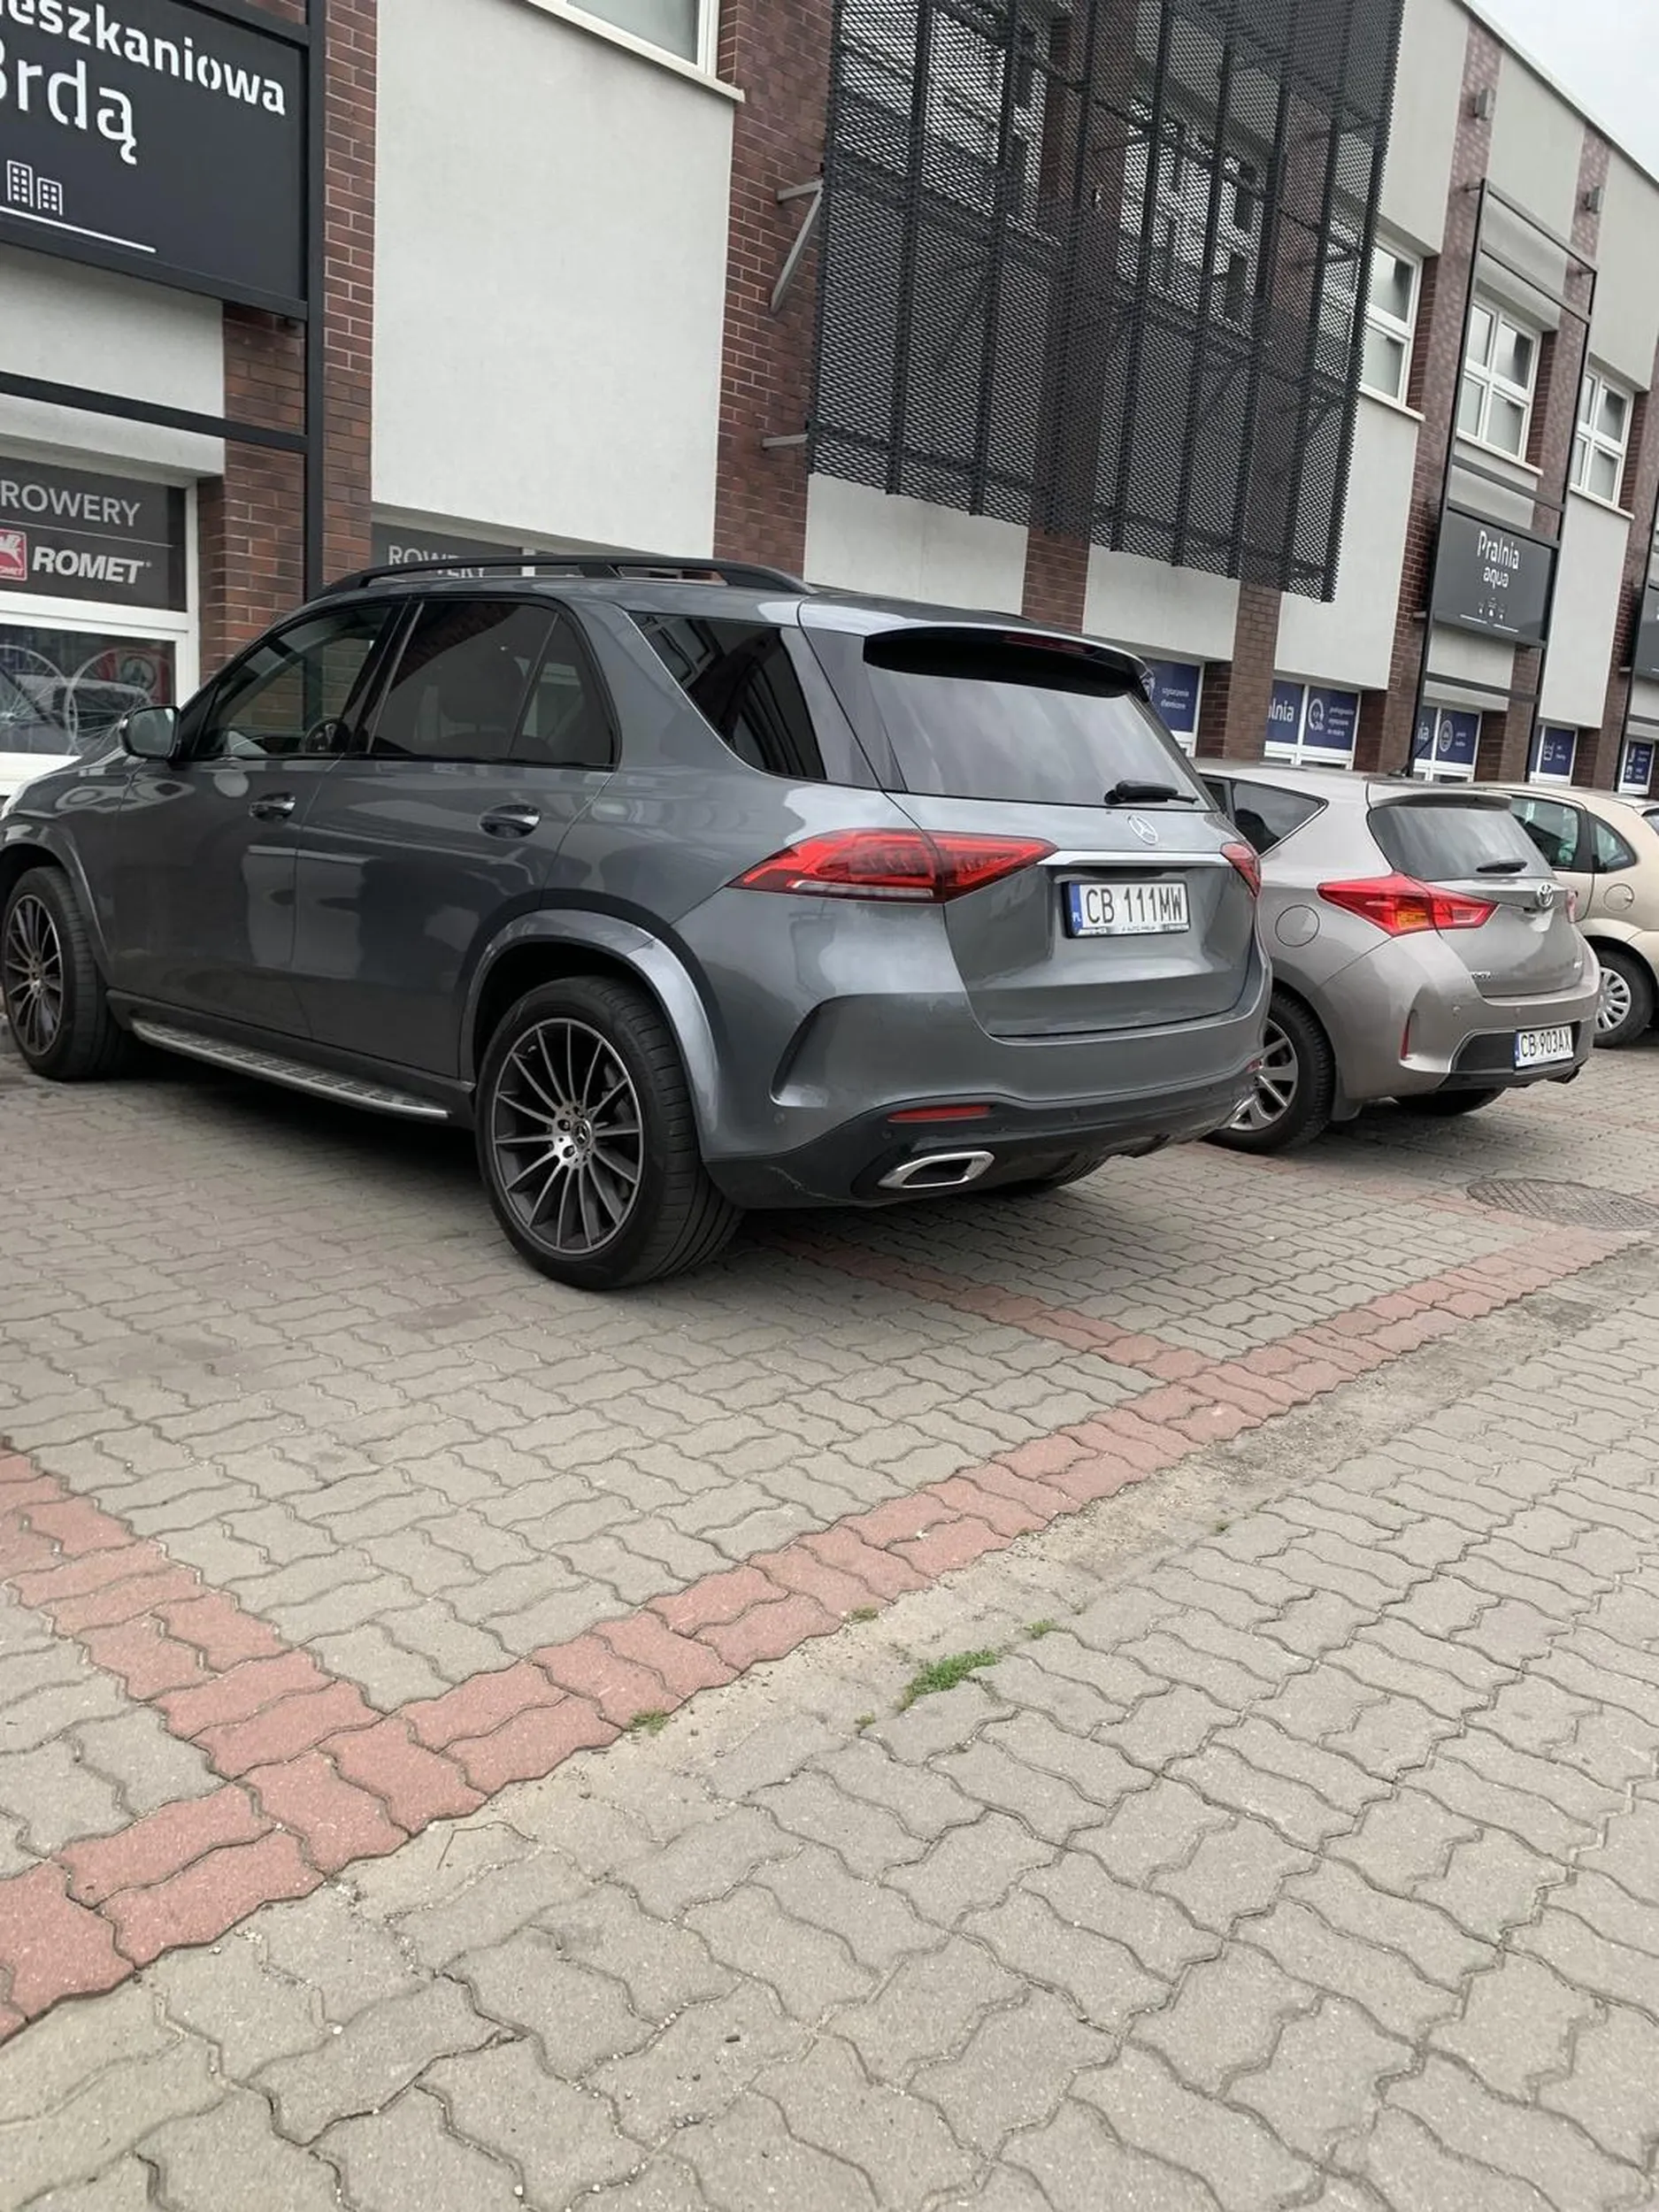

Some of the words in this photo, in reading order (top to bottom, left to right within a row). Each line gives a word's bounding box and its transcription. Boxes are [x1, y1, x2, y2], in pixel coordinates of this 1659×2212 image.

[0, 0, 286, 116] eszkaniowa
[0, 37, 137, 165] rdą
[0, 480, 141, 527] ROWERY
[1477, 530, 1519, 570] Pralnia
[1483, 566, 1509, 589] aqua
[1086, 888, 1115, 924] CB
[1124, 887, 1182, 923] 111MW
[1521, 1033, 1537, 1057] CB
[1539, 1028, 1571, 1056] 903AX
